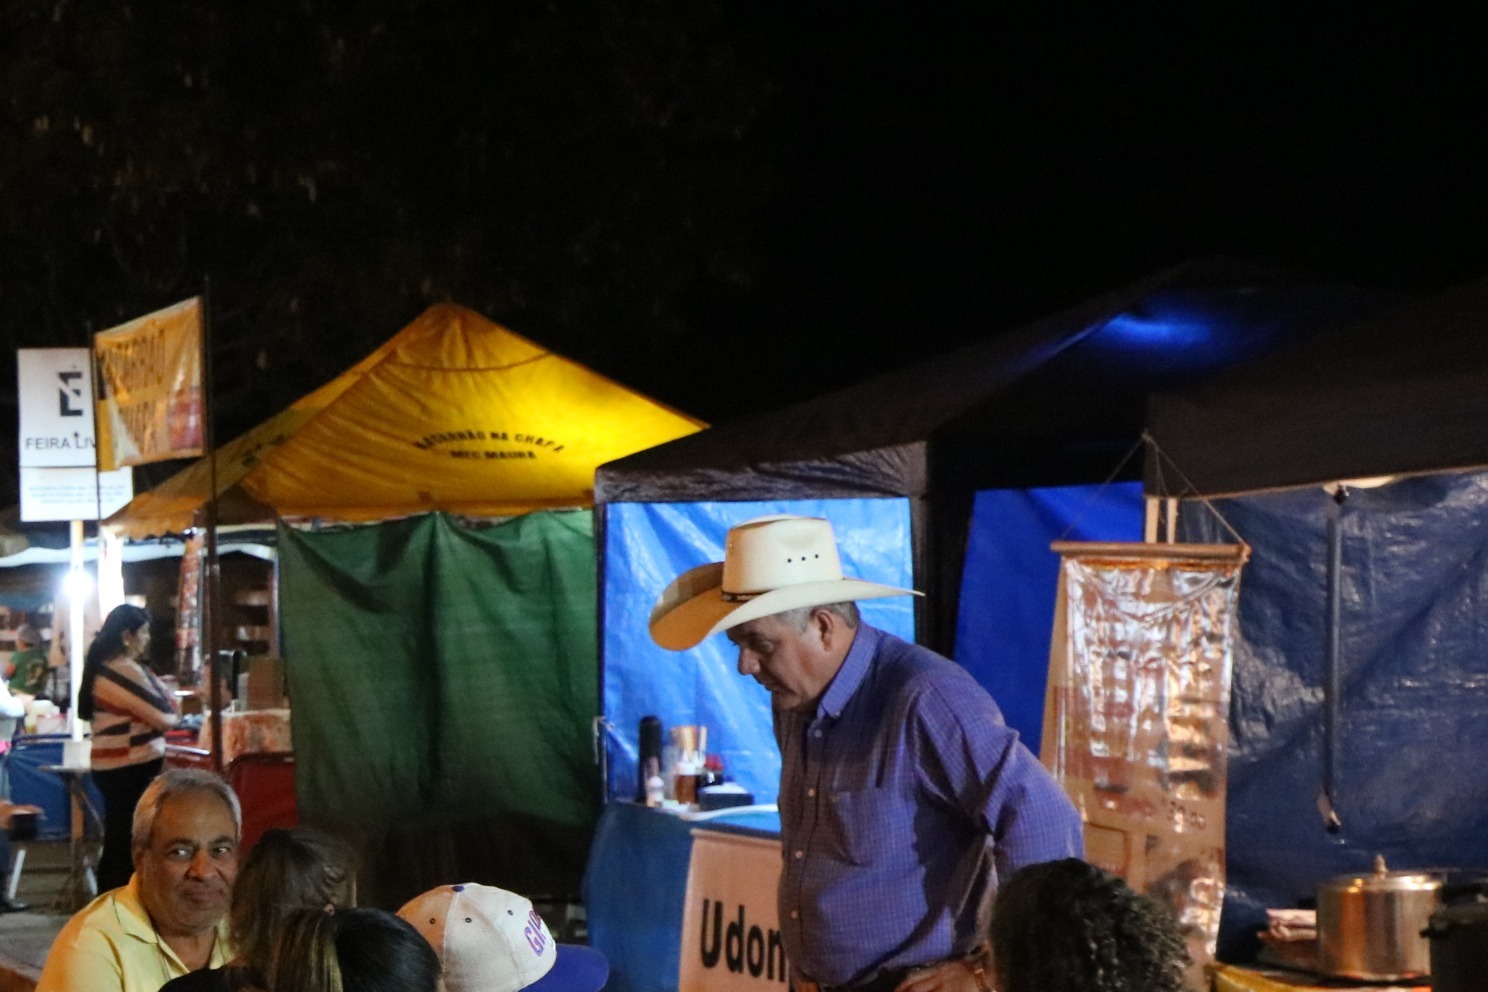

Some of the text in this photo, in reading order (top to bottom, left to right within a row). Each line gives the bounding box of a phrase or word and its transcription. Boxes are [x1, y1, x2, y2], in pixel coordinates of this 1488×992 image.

[25, 437, 71, 450] FEIRA
[490, 431, 509, 442] NA
[514, 433, 565, 452] CHAPA
[700, 898, 786, 984] Udon
